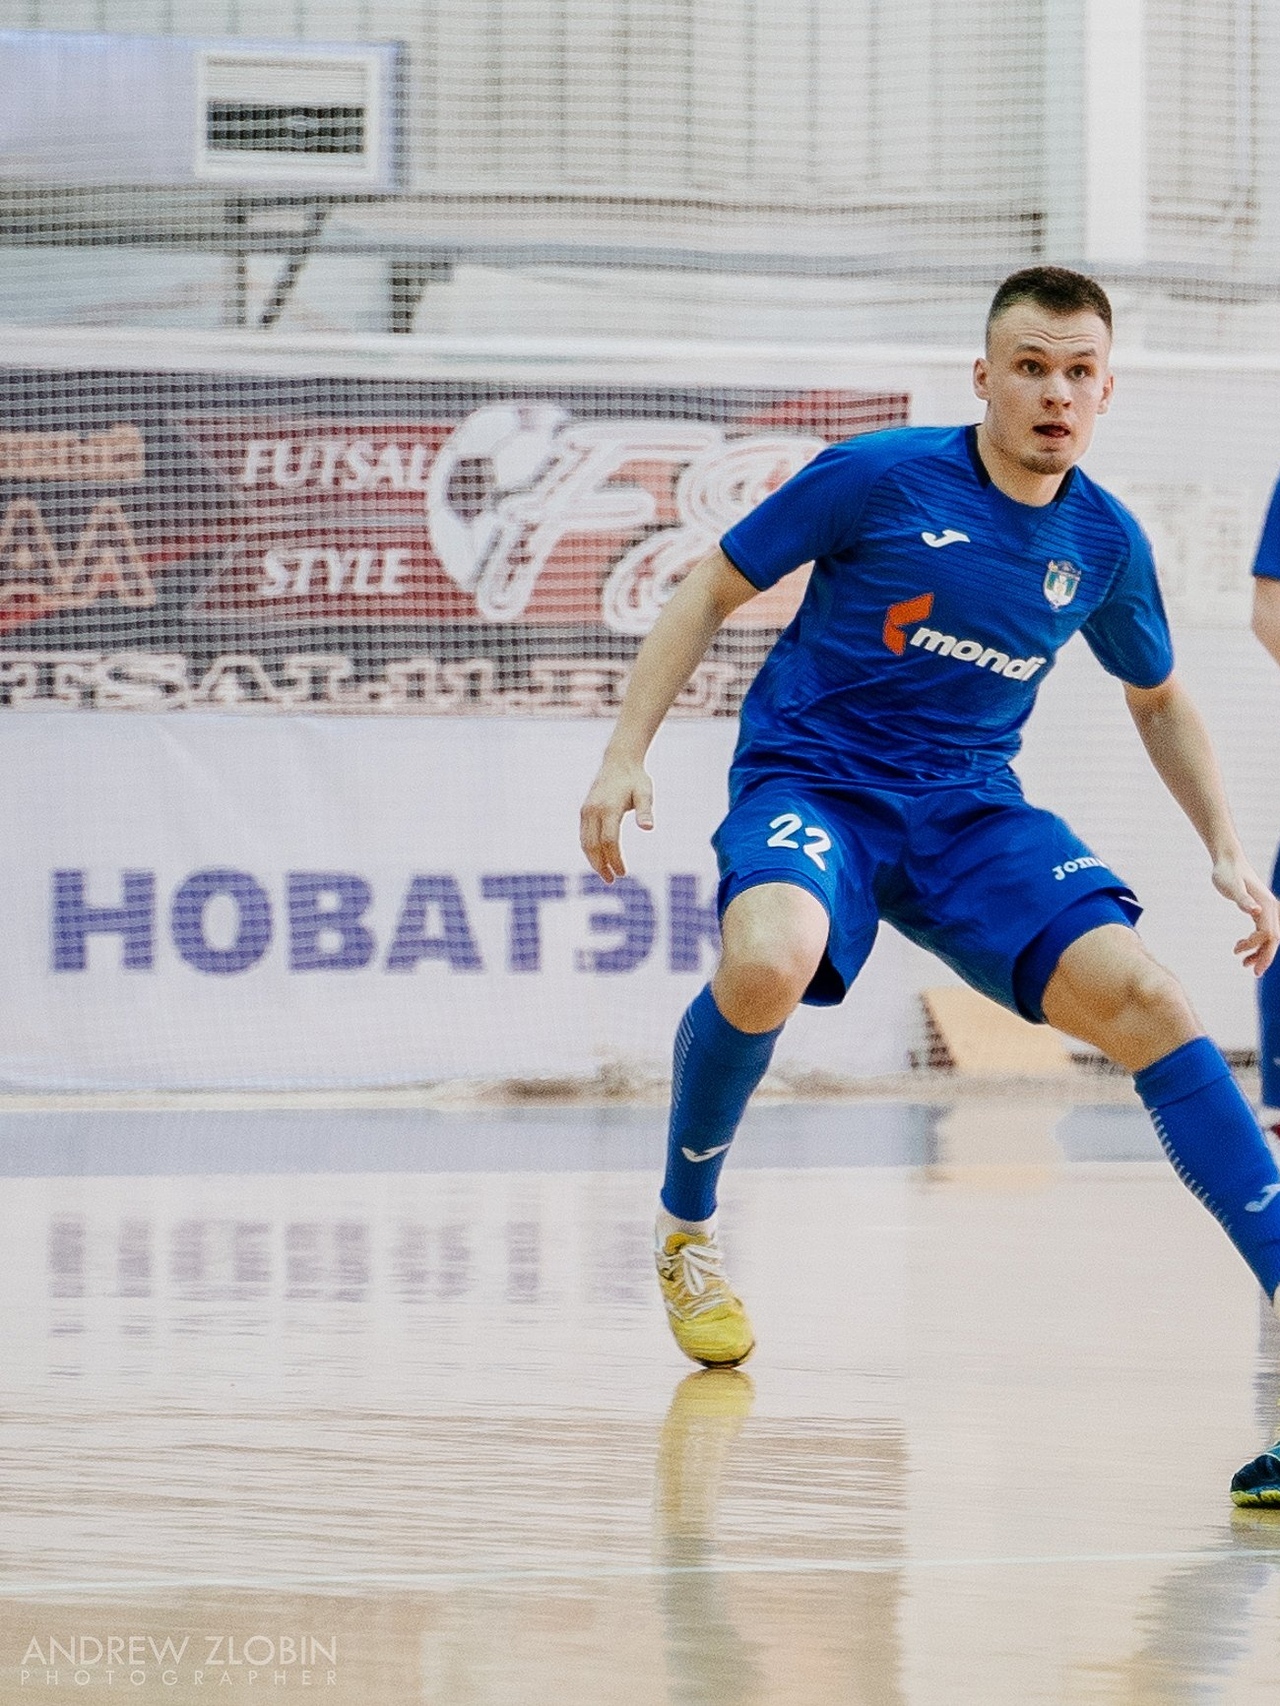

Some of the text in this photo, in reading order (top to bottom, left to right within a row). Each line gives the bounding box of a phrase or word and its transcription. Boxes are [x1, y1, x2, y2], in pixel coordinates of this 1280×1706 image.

[244, 440, 432, 491] FUTSAL
[257, 548, 411, 596] STYLE
[909, 626, 1047, 682] mondi
[766, 813, 832, 872] 22
[50, 867, 722, 976] НОВАТЭК
